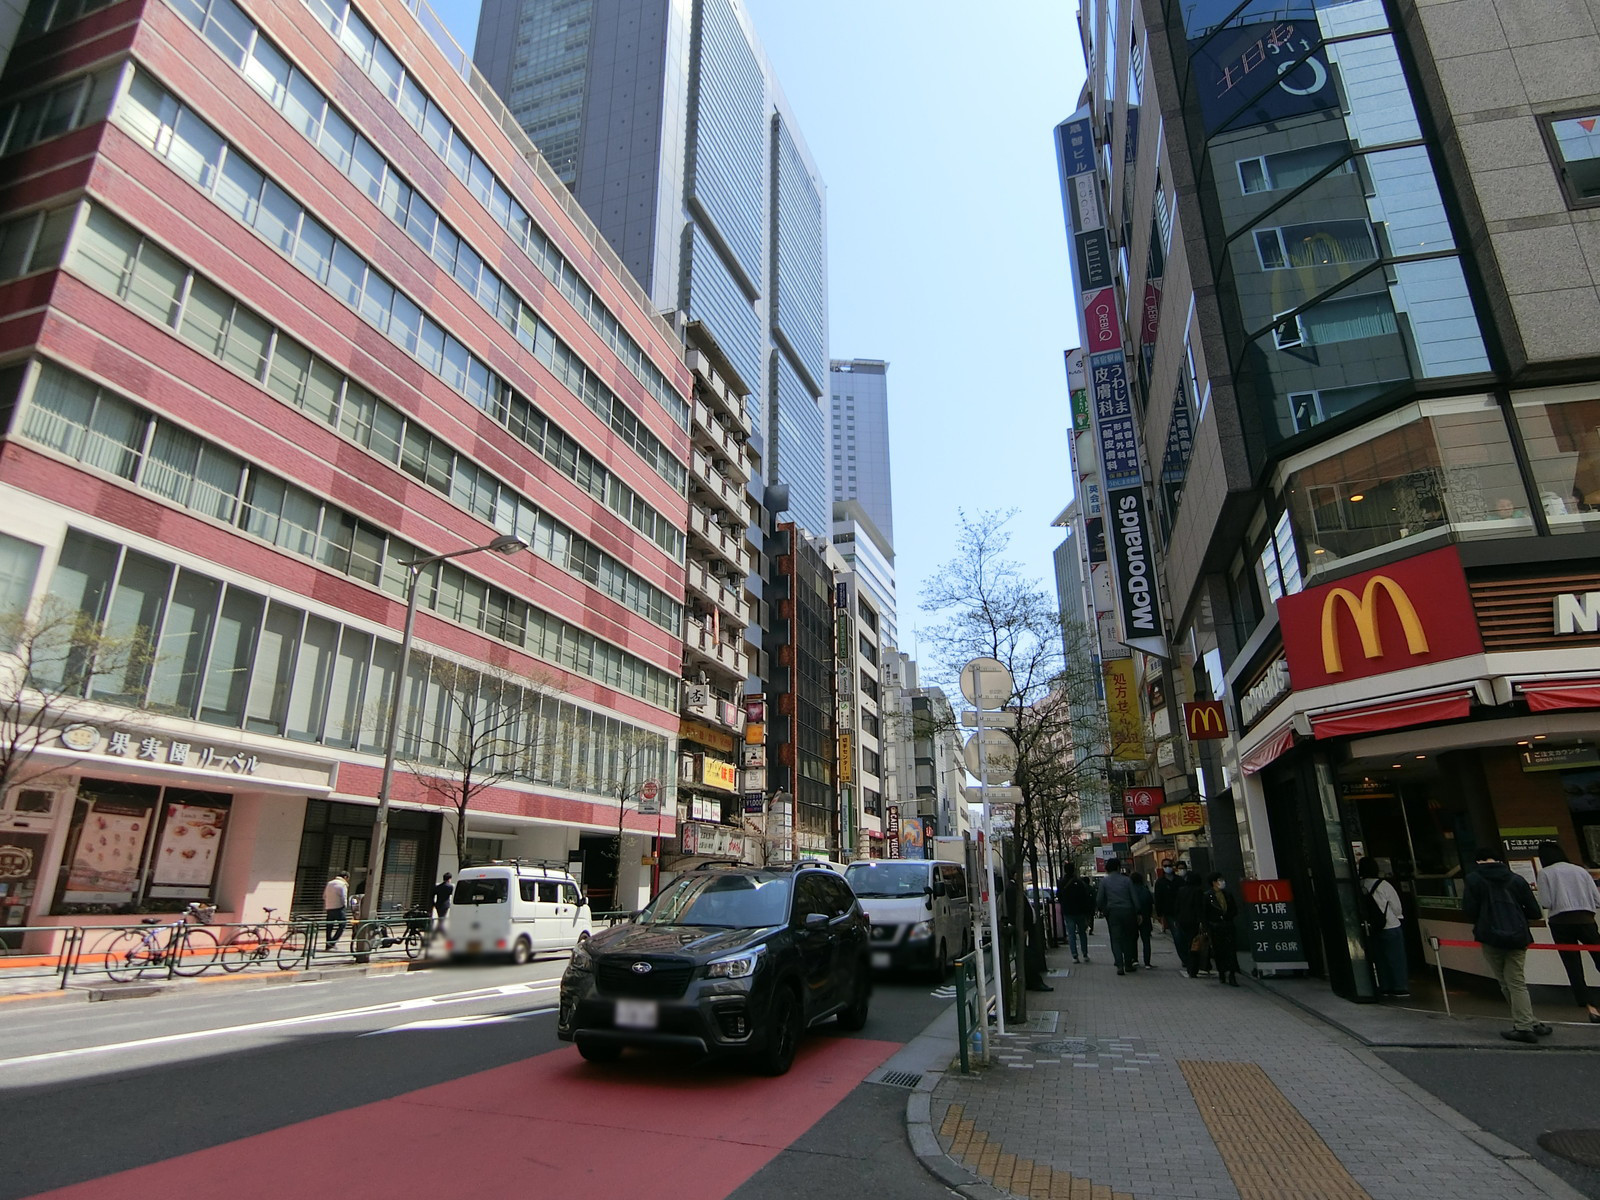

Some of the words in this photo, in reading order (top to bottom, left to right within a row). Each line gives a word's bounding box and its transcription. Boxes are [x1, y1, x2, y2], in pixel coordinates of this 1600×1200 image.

[1087, 238, 1103, 282] BIOTECH
[1096, 304, 1113, 342] CREBIQ
[1095, 367, 1114, 416] 皮膚科
[1110, 365, 1128, 414] うわじま
[1101, 424, 1118, 471] 一般皮膚科
[1089, 485, 1100, 513] 英会話
[1118, 495, 1154, 629] McDonald's
[1523, 752, 1531, 764] 1
[1534, 748, 1588, 758] ご注文カウンター
[890, 814, 898, 832] CAFFE
[1182, 805, 1201, 824] 薬
[891, 838, 899, 859] VELOCE
[1503, 840, 1510, 850] 1
[1510, 838, 1557, 846] ご注文カウー
[1254, 902, 1287, 914] 151席
[1253, 921, 1265, 931] 3F
[1271, 920, 1294, 930] 83席
[1256, 942, 1269, 951] 2F
[1275, 942, 1298, 951] 68席
